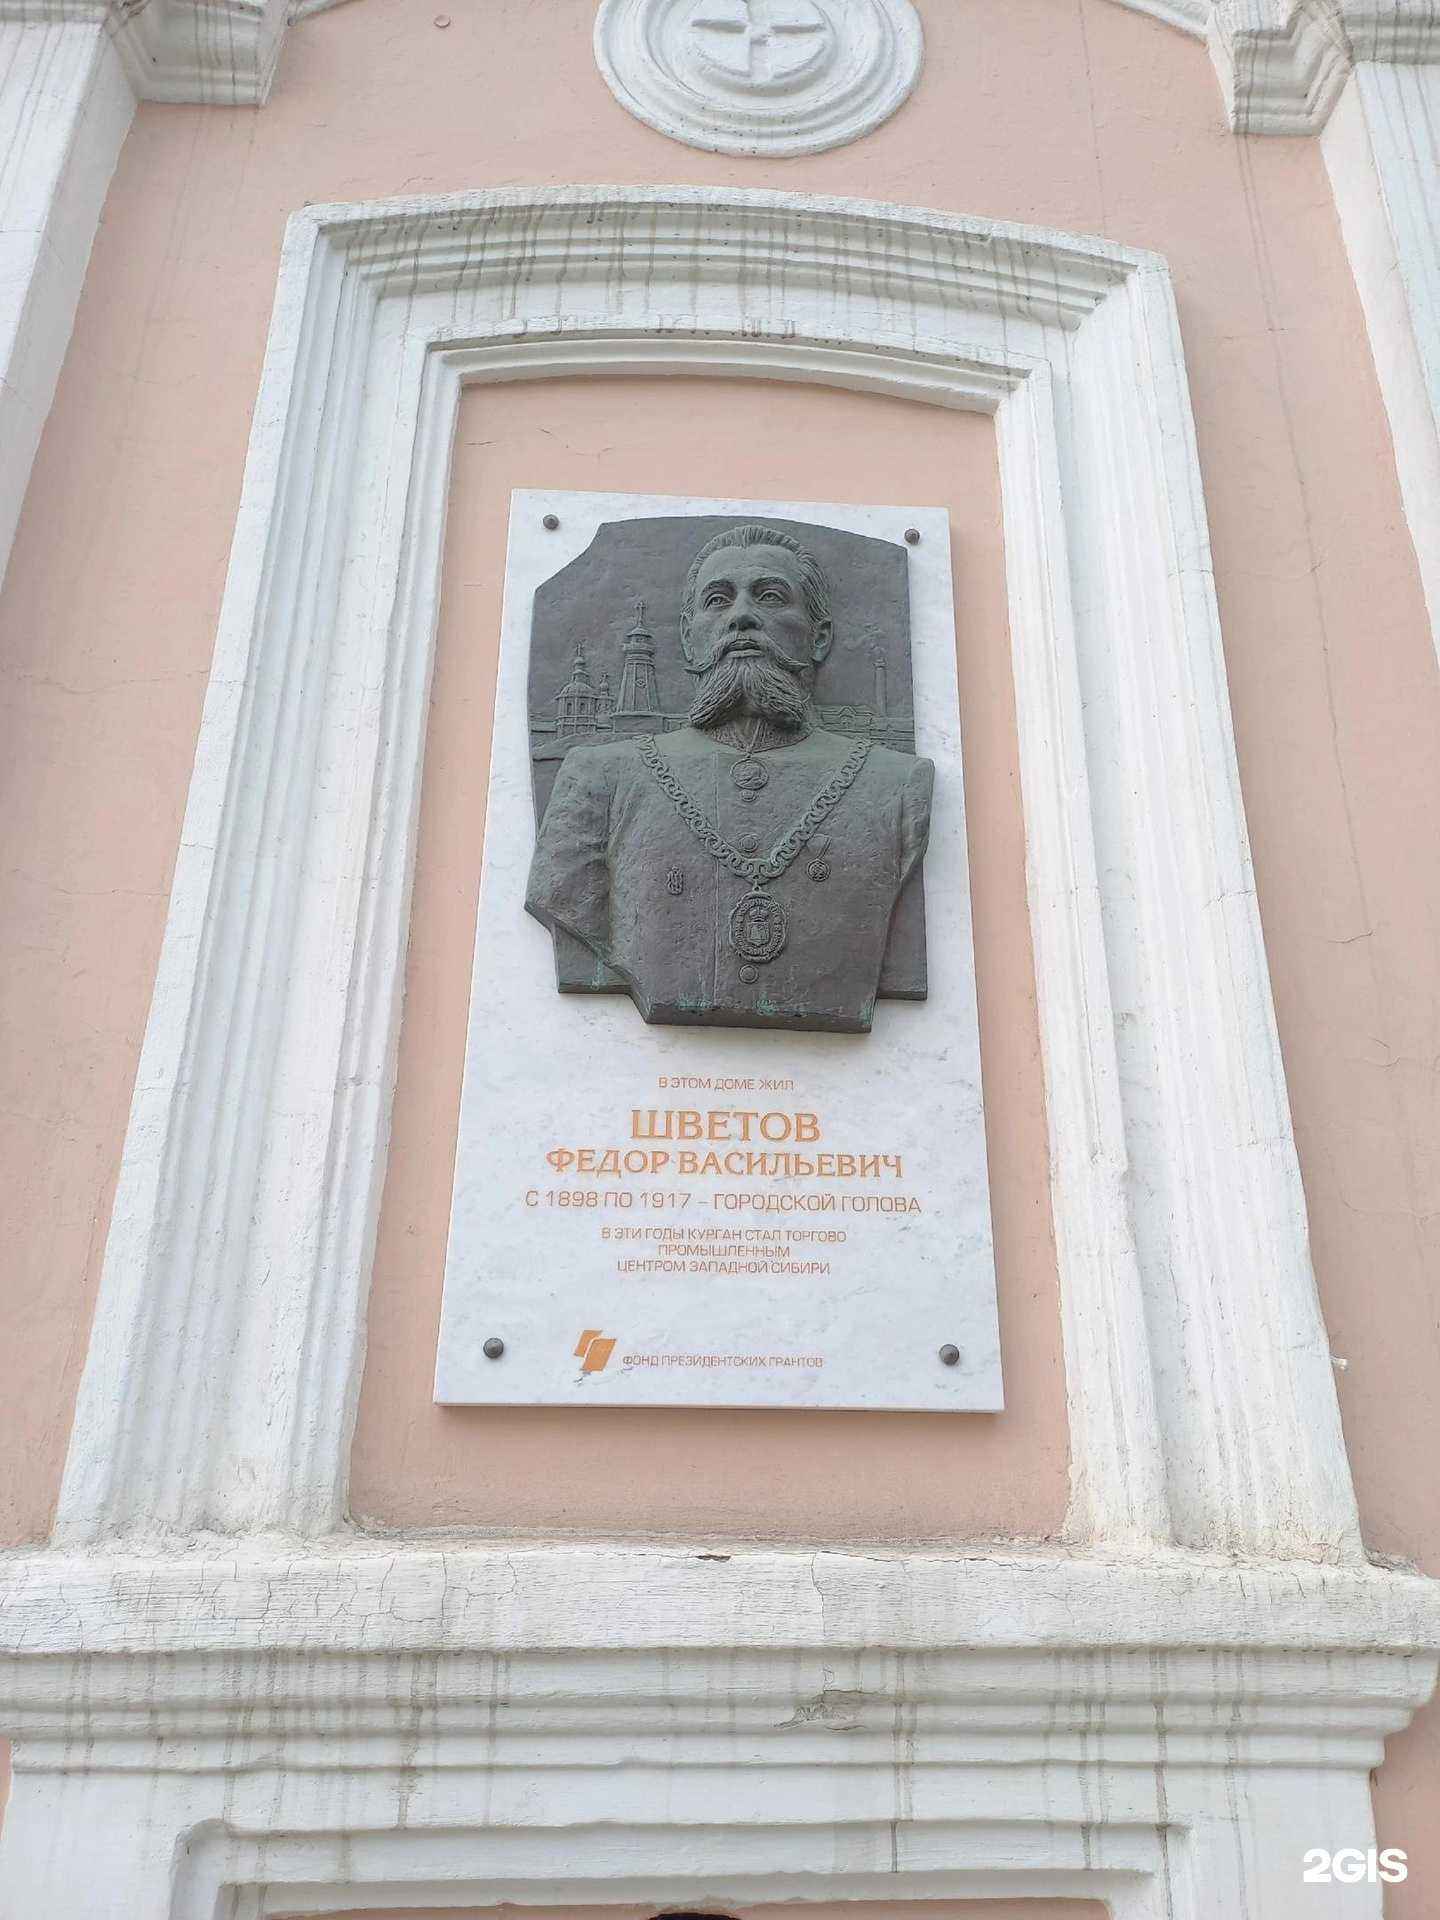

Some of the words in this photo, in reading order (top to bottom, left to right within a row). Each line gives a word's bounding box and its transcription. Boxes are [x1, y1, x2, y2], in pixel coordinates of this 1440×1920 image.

[658, 1076, 668, 1089] В
[671, 1077, 711, 1090] ЭТОМ
[714, 1078, 755, 1092] ДОМЕ
[759, 1079, 794, 1091] ЖИЛ
[631, 1109, 821, 1143] ШВЕТОВ
[546, 1148, 670, 1178] ФЕДОР
[678, 1150, 902, 1178] ВАСИЛЬЕВИЧ
[526, 1190, 539, 1207] С
[546, 1190, 598, 1208] 1898
[604, 1191, 633, 1209] ПО
[641, 1191, 691, 1209] 1917
[714, 1191, 836, 1212] ГОРОДСКОЙ
[841, 1194, 921, 1213] ГОЛОВА
[602, 1228, 611, 1240] В
[613, 1228, 642, 1241] ЭТИ
[645, 1229, 684, 1242] ГОДЫ
[688, 1229, 742, 1241] КУРГАН
[745, 1230, 782, 1242] СТАЛ
[784, 1230, 847, 1243] ТОРГОВО
[658, 1244, 790, 1258] ПРОМЫШЛЕННЫМ
[617, 1260, 686, 1275] ЦЕНТРОМ
[689, 1259, 768, 1275] ЗАПАДНОЙ
[771, 1262, 830, 1275] СИБИРИ
[622, 1355, 659, 1367] ФОНД
[661, 1355, 767, 1368] ПРЕЗИДЕНТСКИХ
[769, 1356, 823, 1368] ГРАНТОВ
